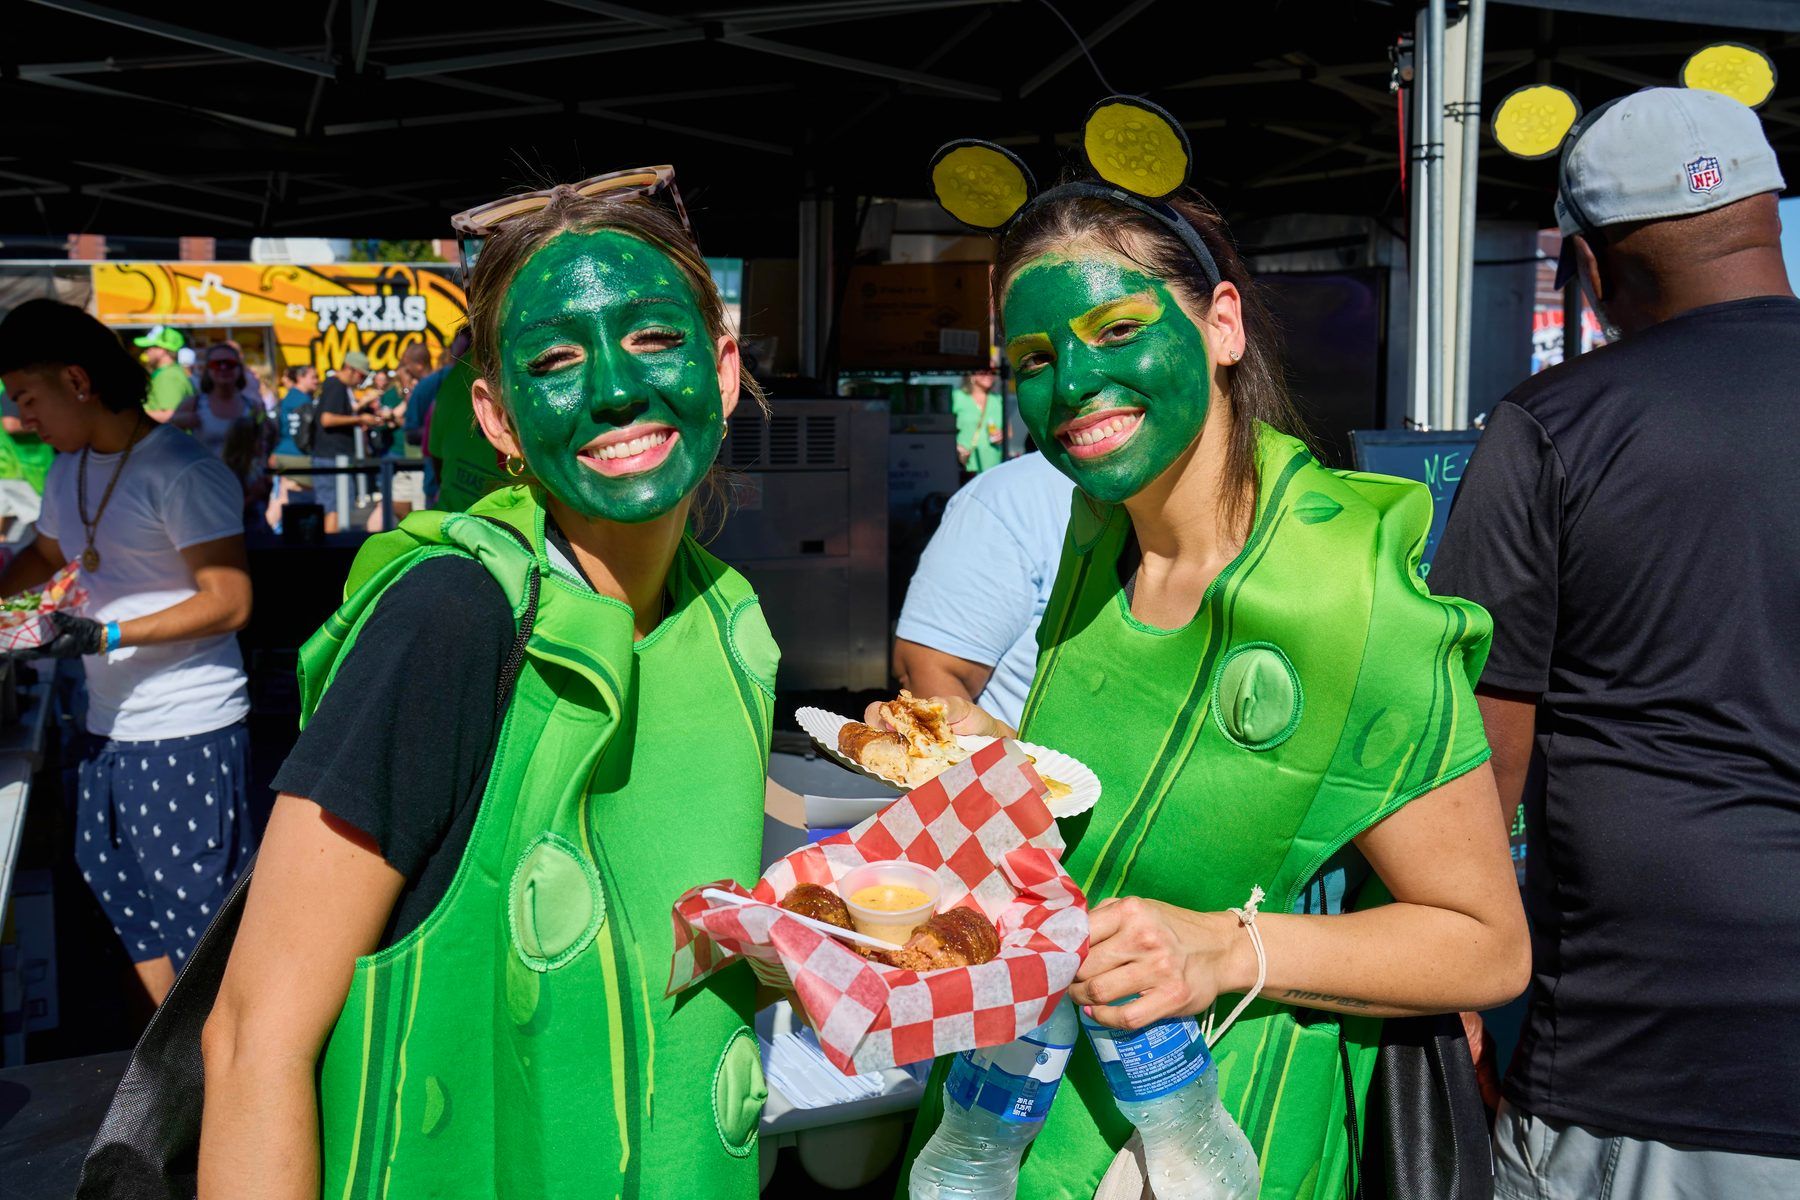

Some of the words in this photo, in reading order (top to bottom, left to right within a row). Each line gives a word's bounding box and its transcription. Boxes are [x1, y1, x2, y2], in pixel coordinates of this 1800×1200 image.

[1693, 170, 1719, 189] NFL
[312, 295, 427, 331] TEXAS
[1423, 451, 1469, 490] ME
